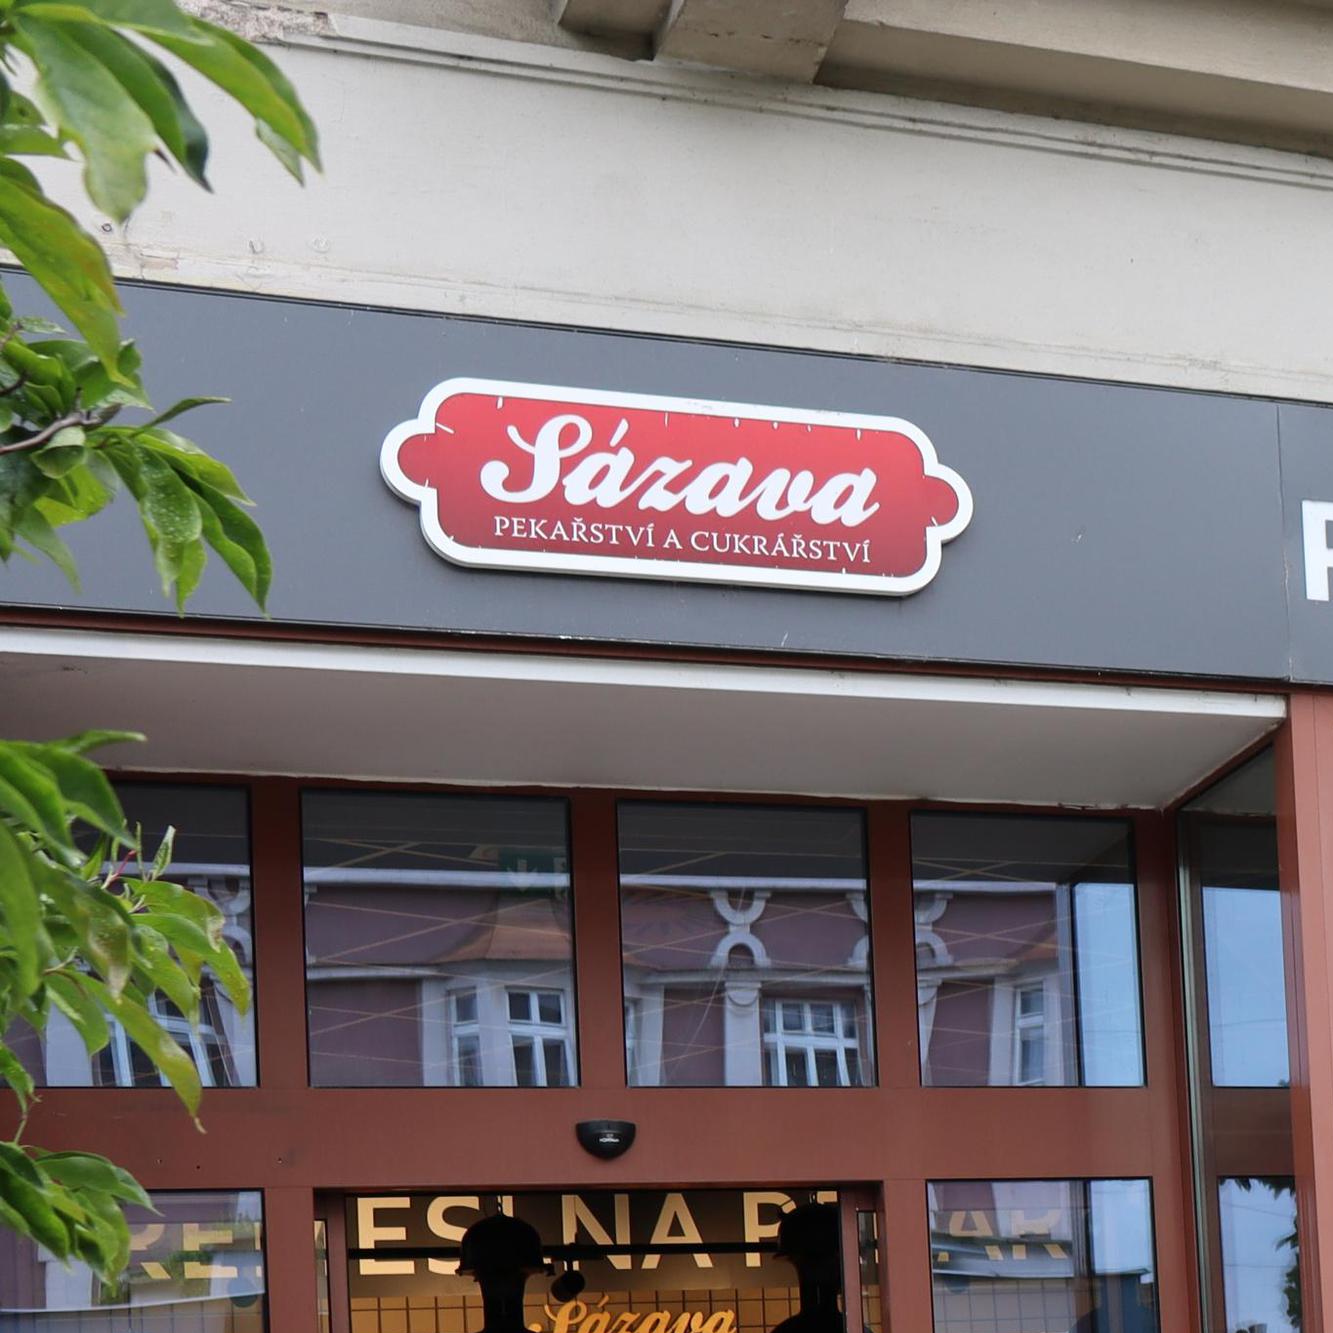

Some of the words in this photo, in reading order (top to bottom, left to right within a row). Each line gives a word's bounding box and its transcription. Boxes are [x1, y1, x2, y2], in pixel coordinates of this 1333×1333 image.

[479, 413, 881, 528] Sázava
[494, 513, 658, 549] PEKAŘSTVÍ
[664, 530, 684, 550] A
[690, 530, 872, 564] CUKRÁŘSTVÍ
